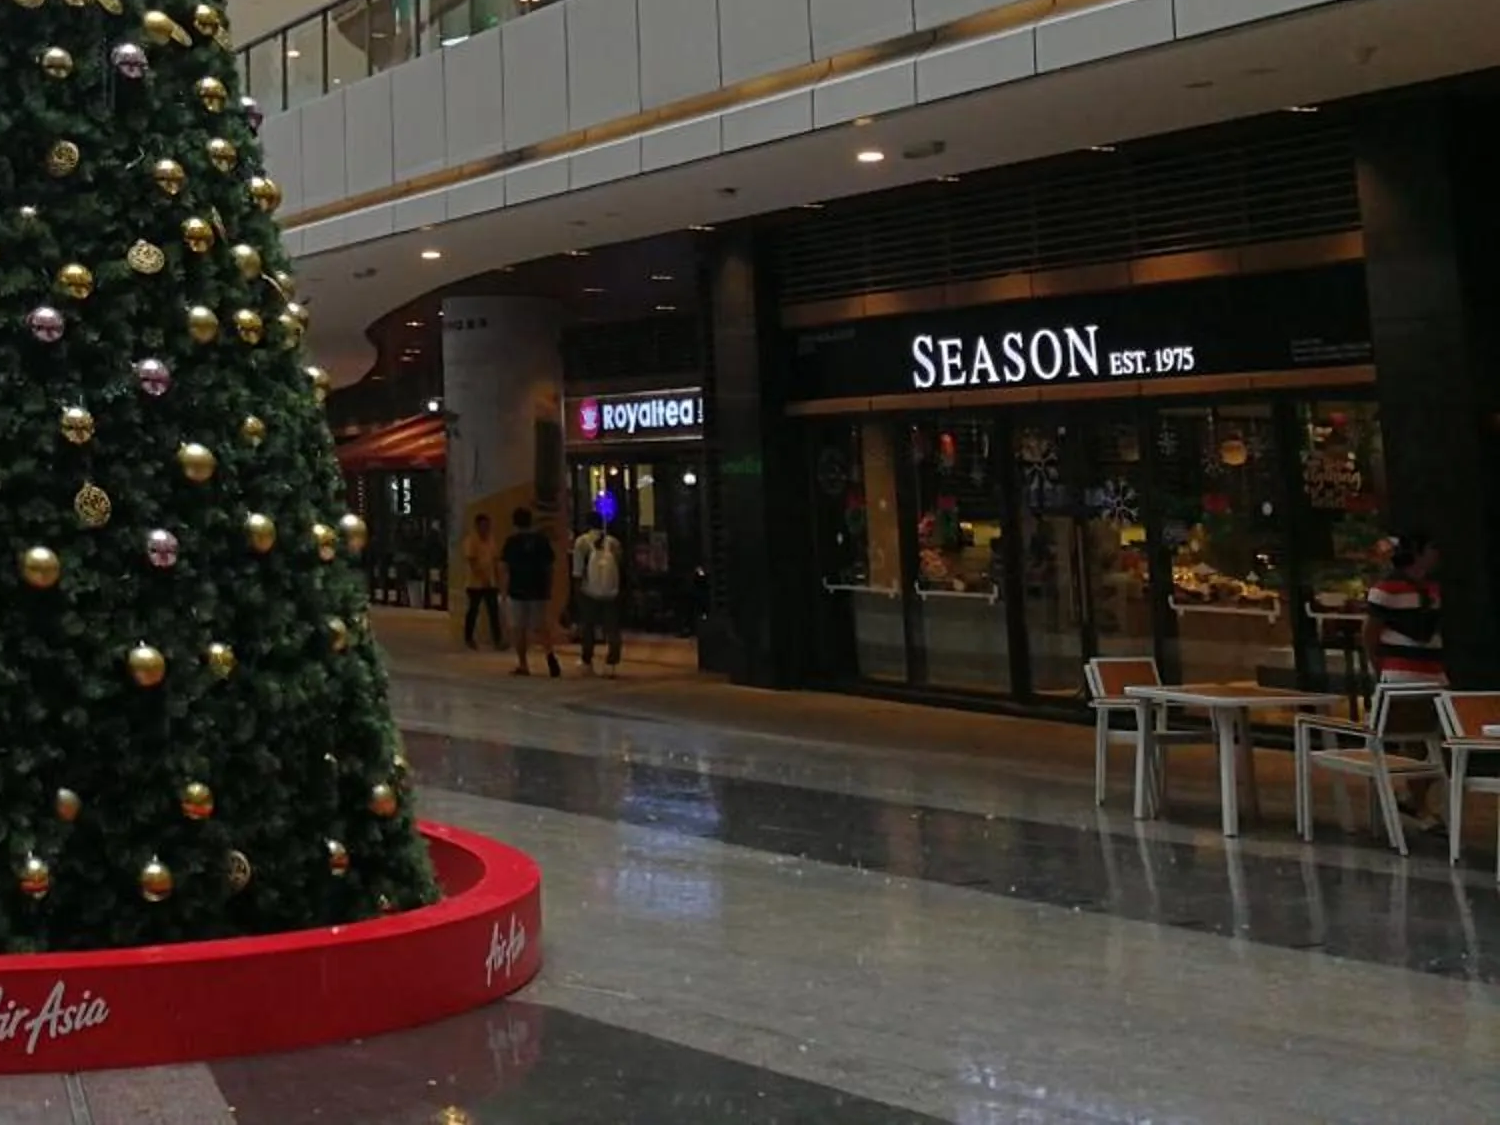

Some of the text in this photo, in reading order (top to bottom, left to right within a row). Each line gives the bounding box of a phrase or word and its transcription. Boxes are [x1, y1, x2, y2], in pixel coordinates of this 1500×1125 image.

[912, 325, 1195, 389] SEASON EST. 1975
